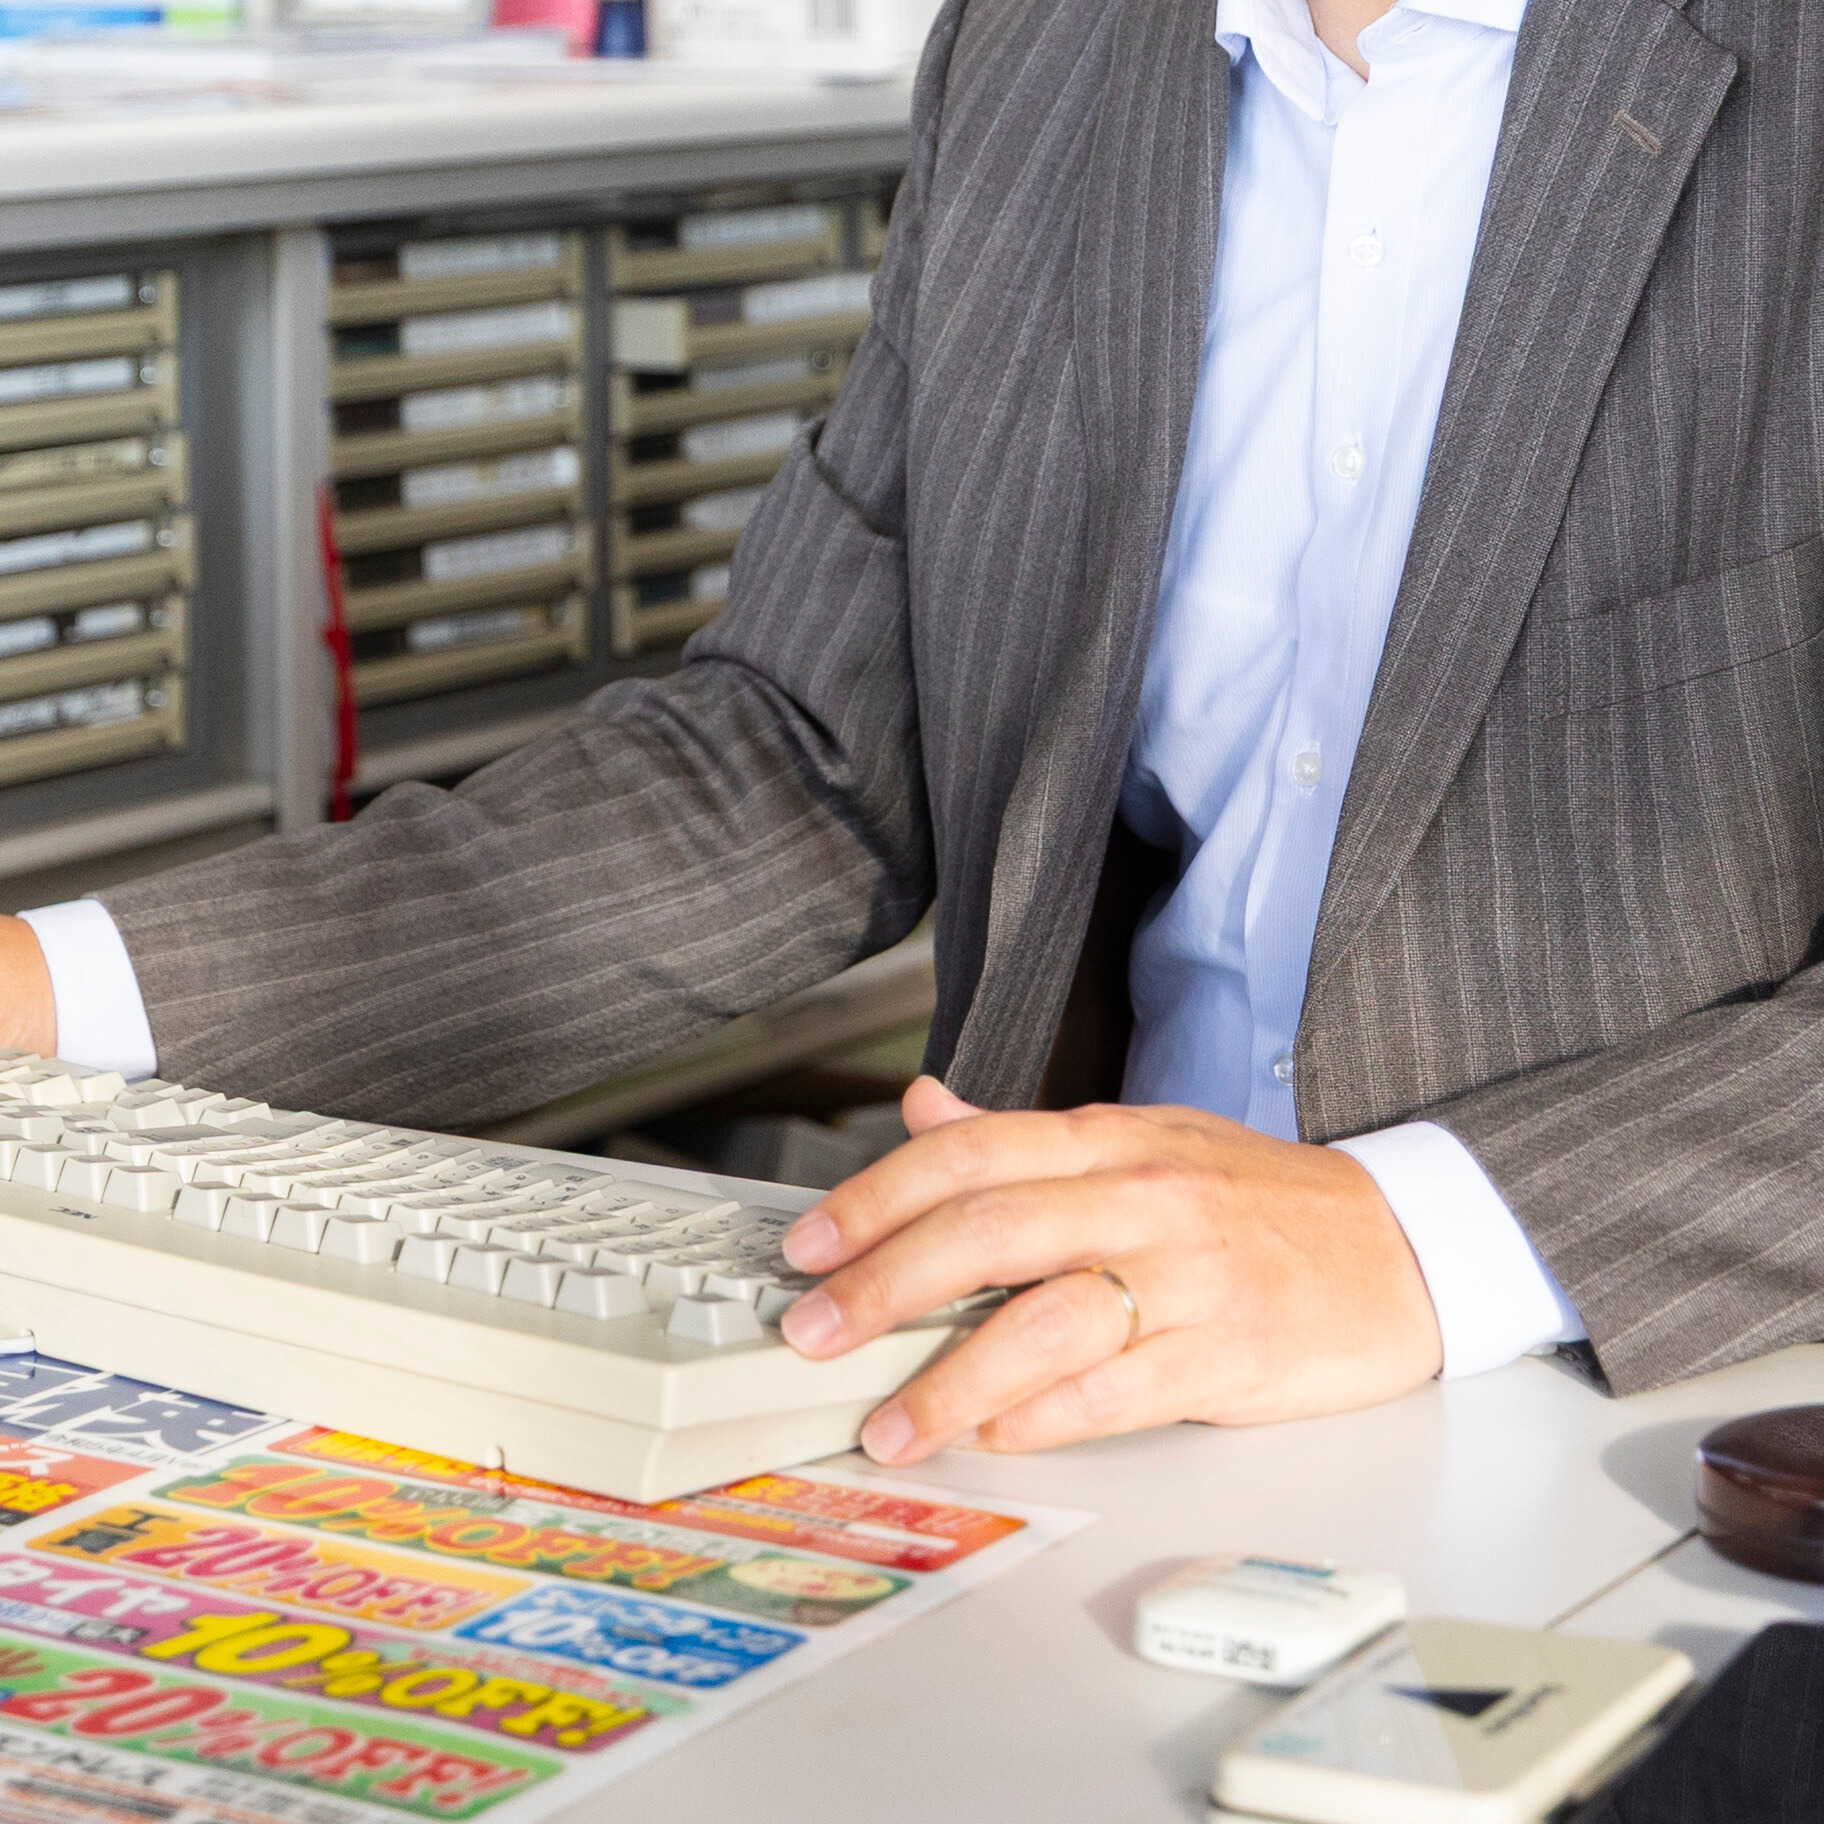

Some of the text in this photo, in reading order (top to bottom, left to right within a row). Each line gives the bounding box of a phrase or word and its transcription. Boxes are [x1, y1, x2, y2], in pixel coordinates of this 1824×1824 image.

[112, 1525, 498, 1626] 20%OFF!
[166, 1462, 728, 1592] 10%OFF!
[139, 1611, 648, 1747] 10%OFF!
[478, 1608, 740, 1680] 10%OFF
